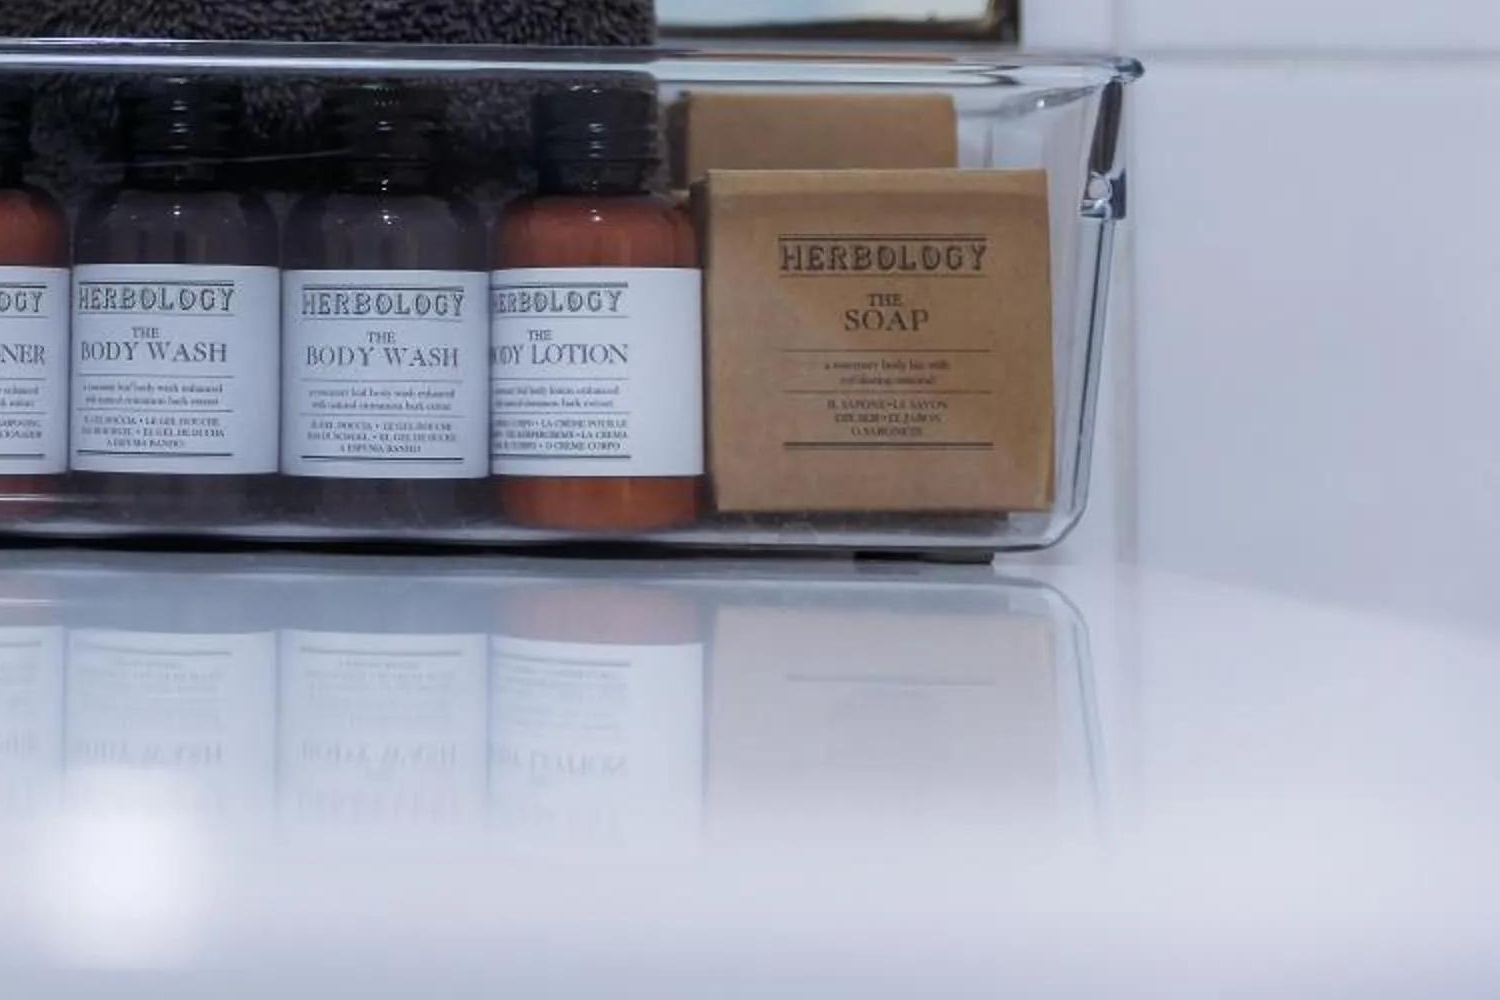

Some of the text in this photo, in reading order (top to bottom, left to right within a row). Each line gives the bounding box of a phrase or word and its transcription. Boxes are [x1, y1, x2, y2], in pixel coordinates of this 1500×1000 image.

[780, 245, 988, 271] HERBOLOGY
[78, 287, 235, 311] HERBOLOGY
[301, 293, 464, 317] HERBOLOGY
[867, 293, 903, 307] THE
[843, 309, 930, 332] SOAP
[132, 327, 160, 339] THE
[366, 331, 396, 344] THE
[529, 329, 552, 341] THE
[81, 341, 227, 363] BODY WASH
[306, 346, 459, 368] BODY WASH
[532, 343, 628, 365] LOTION
